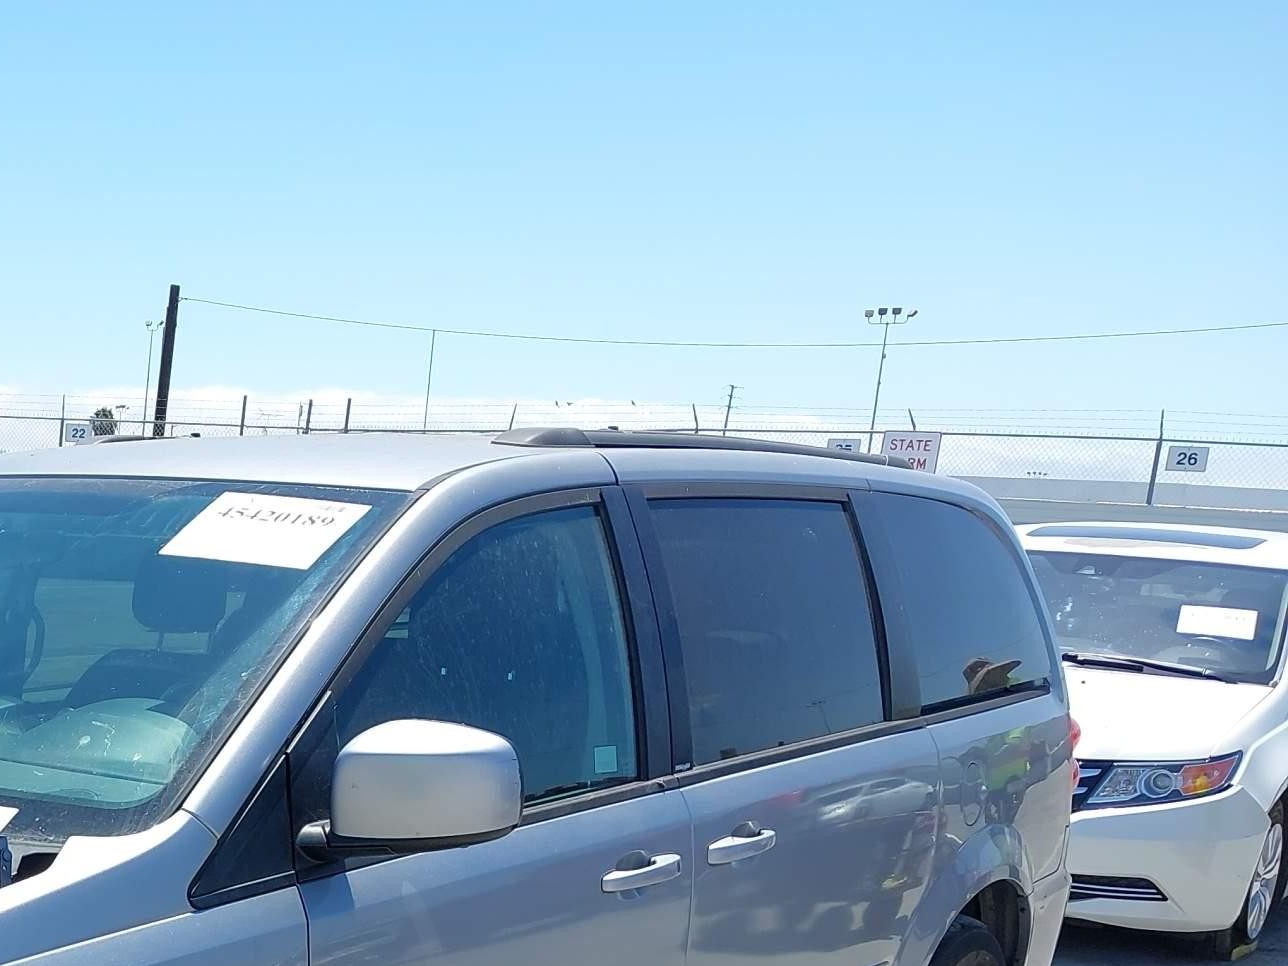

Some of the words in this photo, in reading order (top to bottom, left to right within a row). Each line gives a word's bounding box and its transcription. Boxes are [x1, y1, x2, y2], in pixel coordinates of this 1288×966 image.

[71, 427, 86, 439] 22
[889, 438, 932, 452] STATE
[1176, 451, 1199, 466] 26
